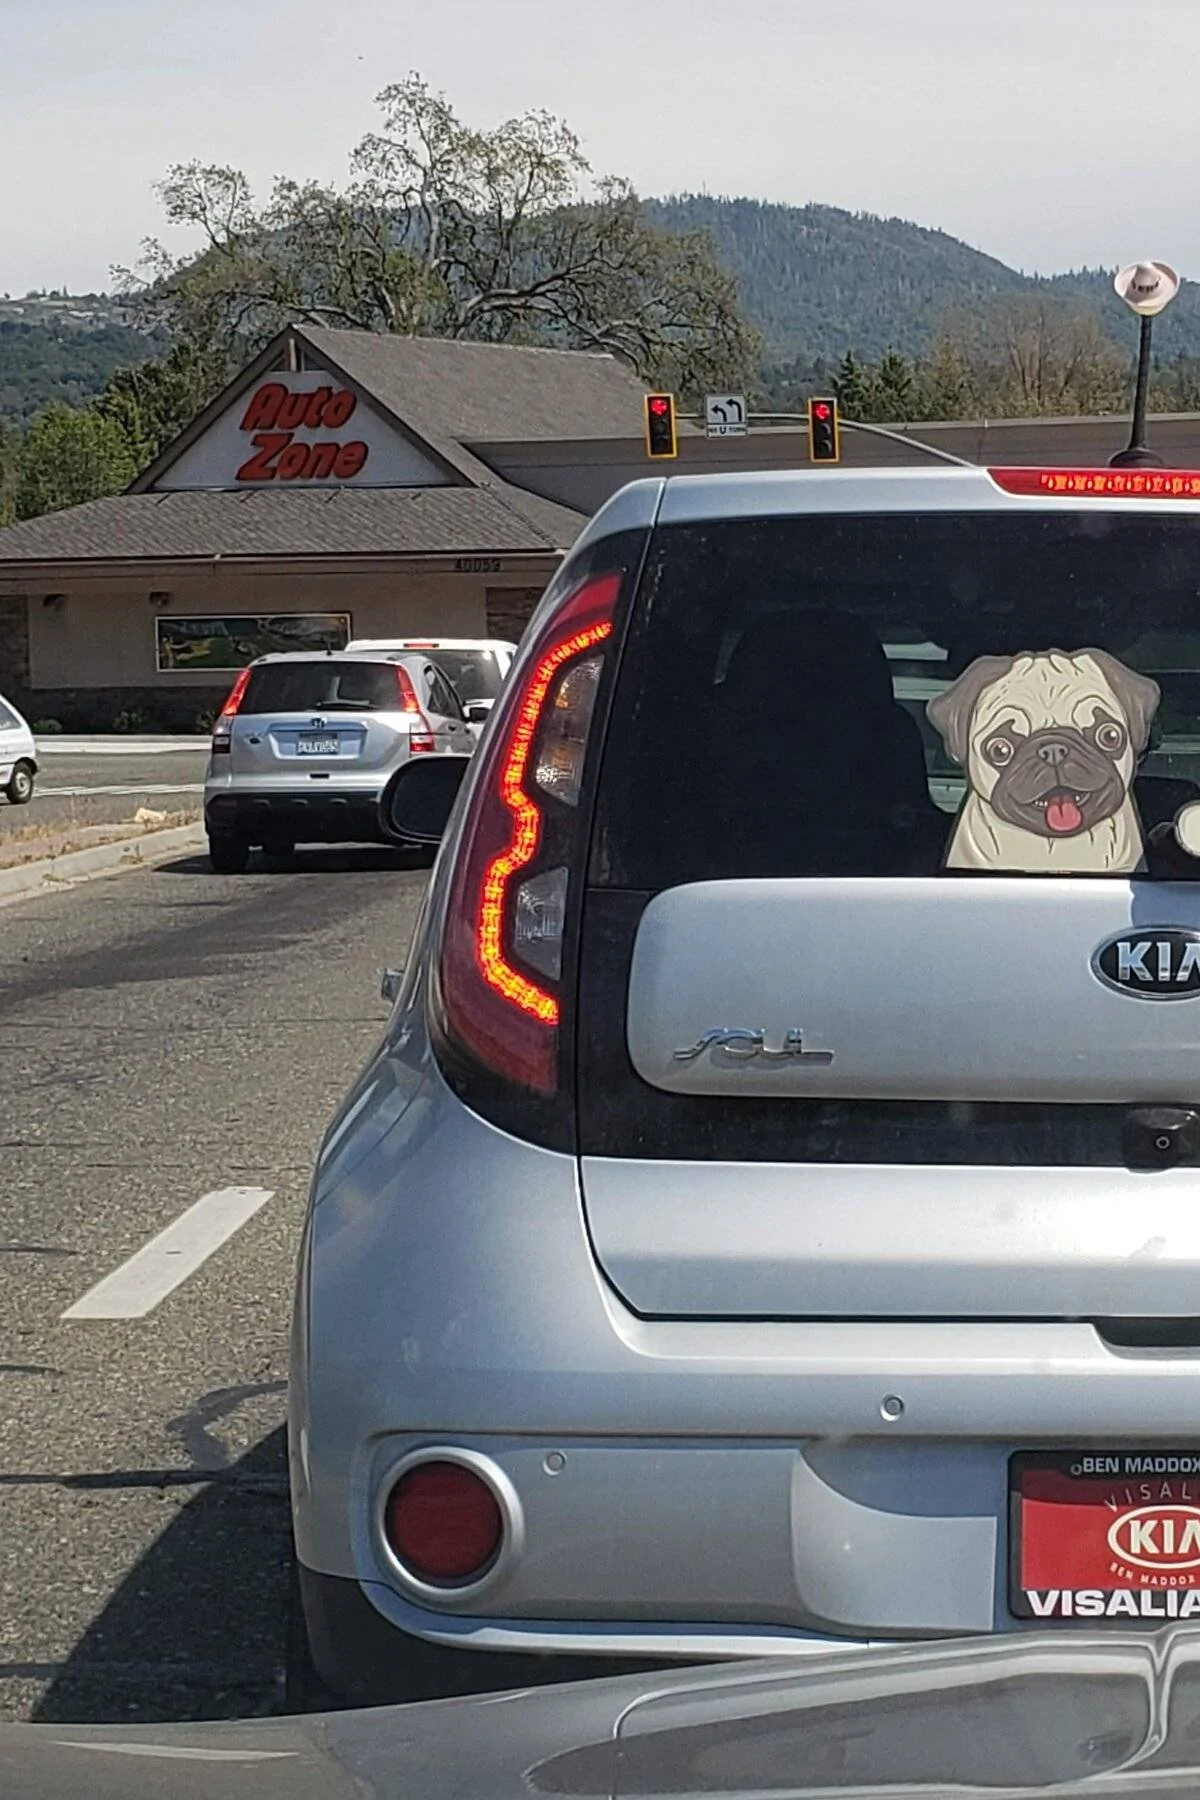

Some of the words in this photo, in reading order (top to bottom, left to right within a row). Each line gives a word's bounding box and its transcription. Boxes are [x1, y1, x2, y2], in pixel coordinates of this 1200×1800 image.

[239, 382, 358, 431] Auto
[235, 432, 370, 481] Zone
[1082, 1457, 1119, 1474] BEN
[1109, 1562, 1134, 1580] BEN
[1140, 1574, 1195, 1586] MADDOX
